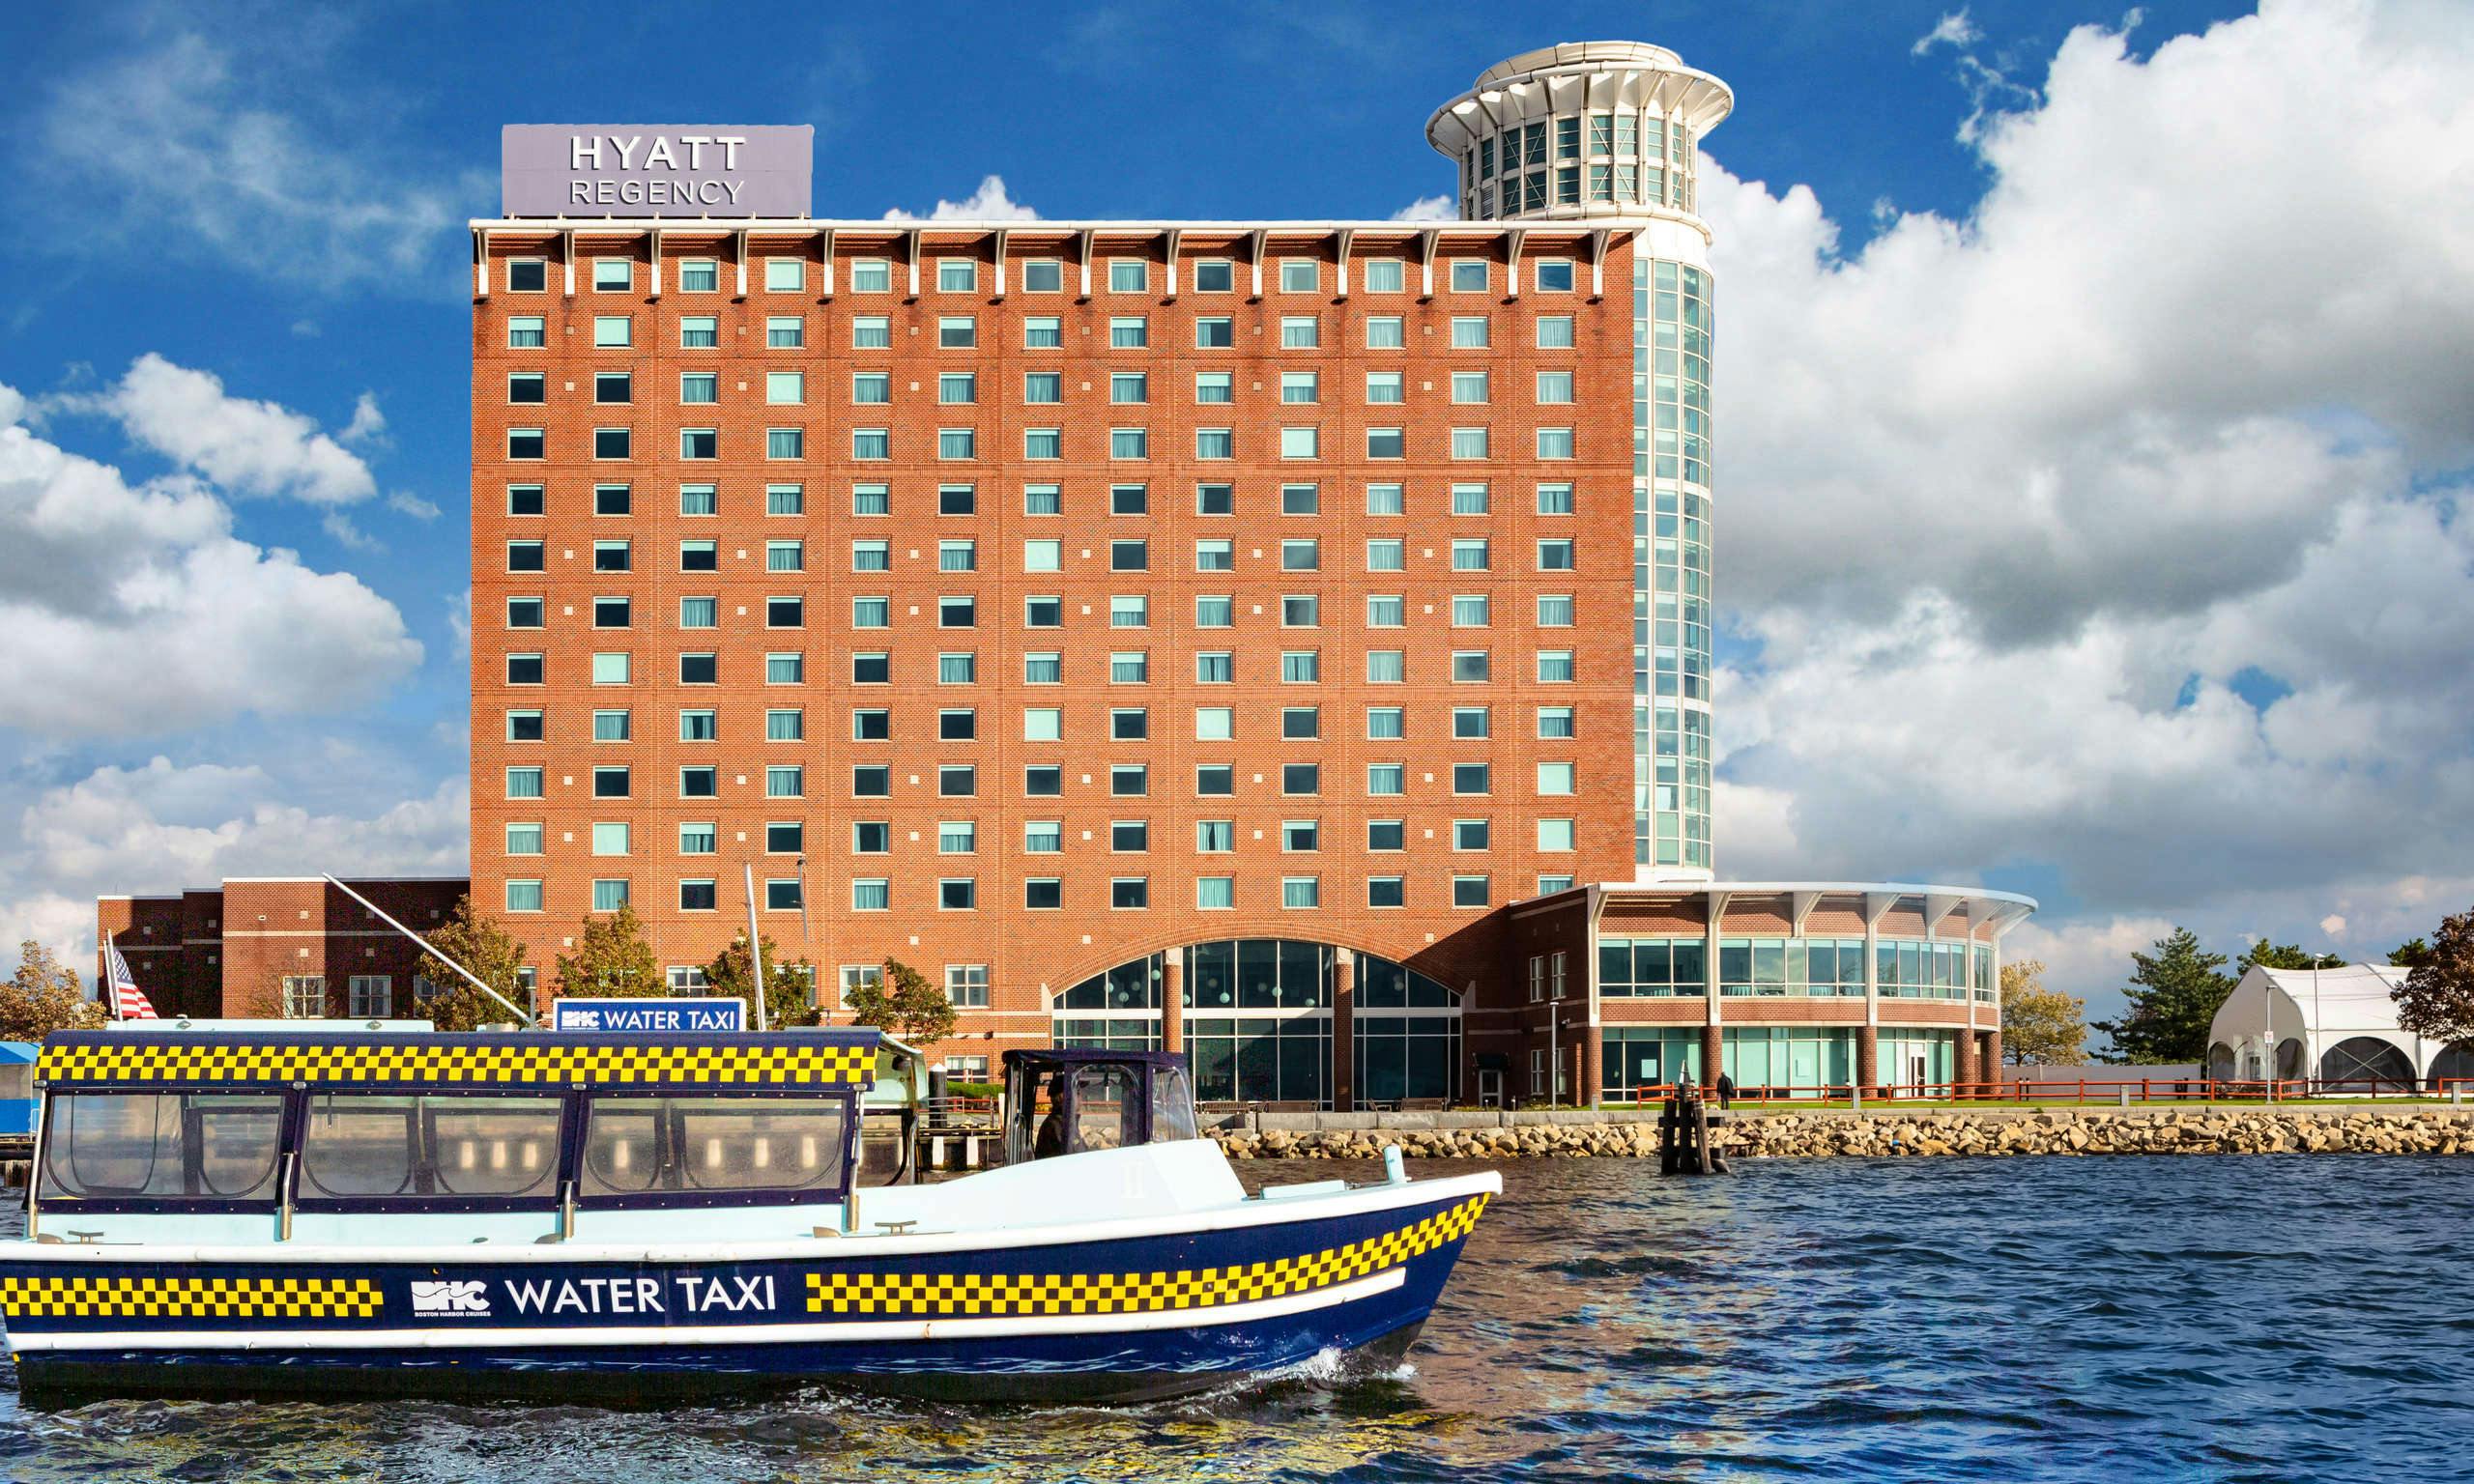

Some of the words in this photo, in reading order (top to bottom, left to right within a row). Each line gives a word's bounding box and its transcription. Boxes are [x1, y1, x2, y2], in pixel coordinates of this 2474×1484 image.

[571, 136, 746, 170] HYATT
[571, 180, 745, 204] REGENCY
[604, 1011, 680, 1030] WATER
[687, 1011, 734, 1030] TAXI
[411, 1280, 491, 1311] BHC
[503, 1278, 666, 1314] WATER
[676, 1274, 776, 1312] TAXI
